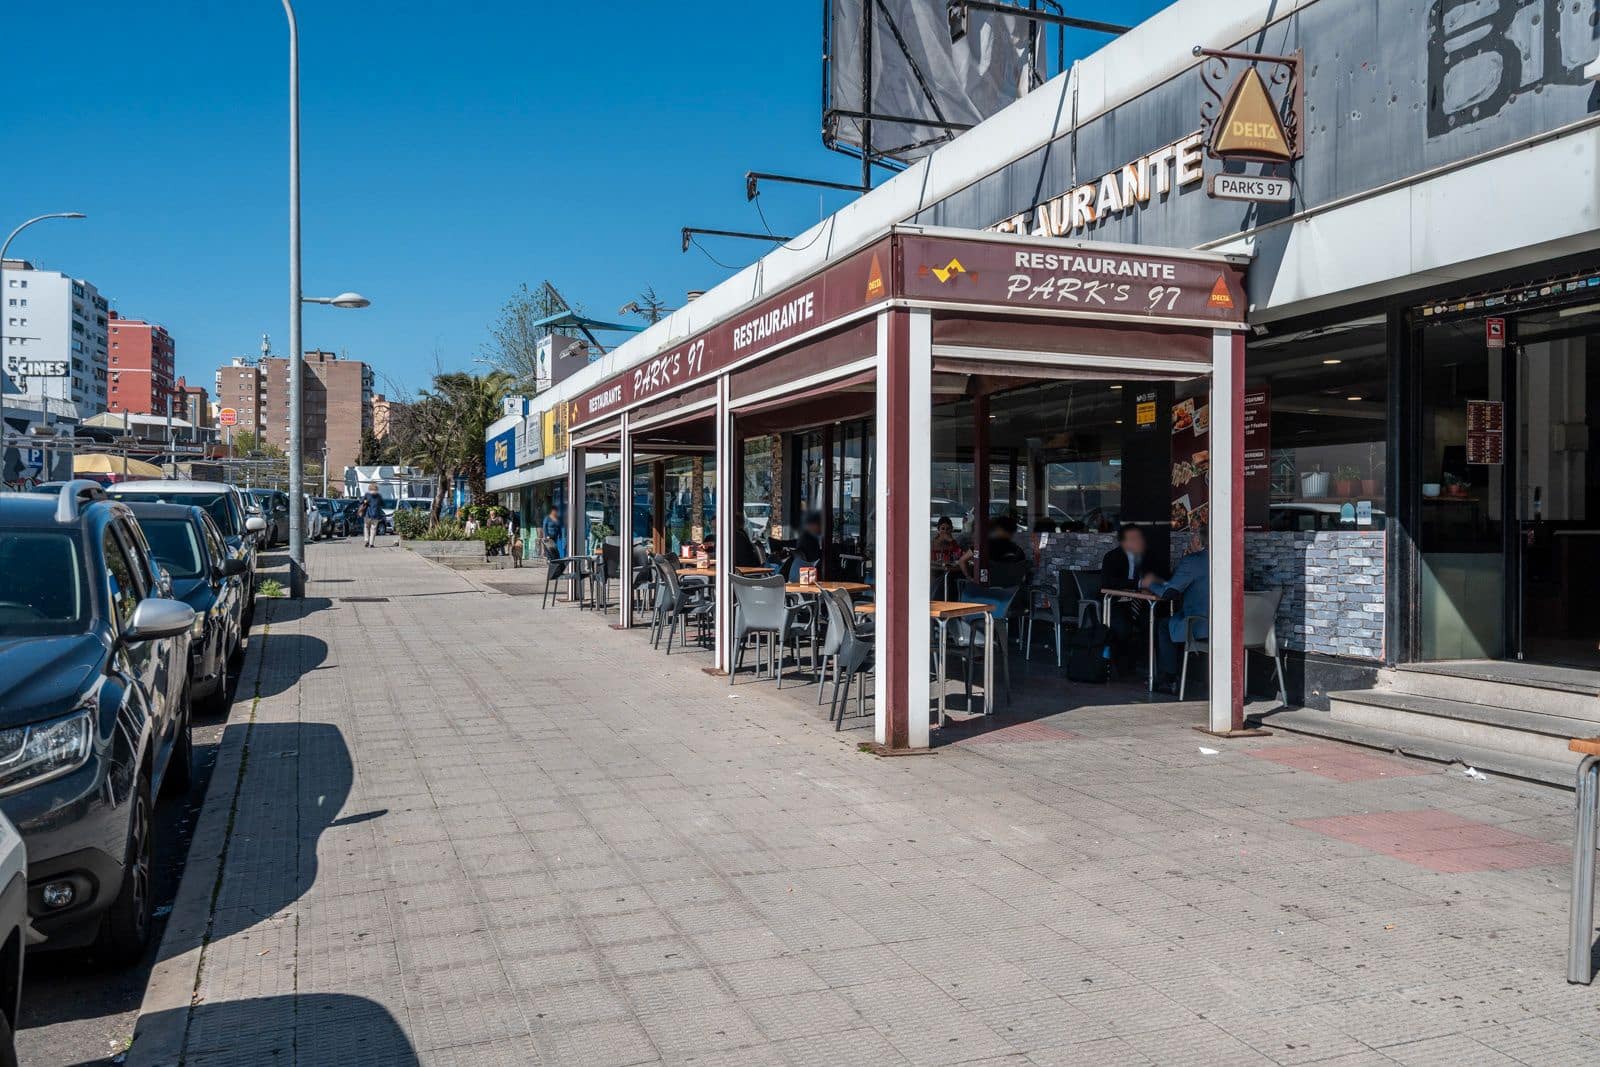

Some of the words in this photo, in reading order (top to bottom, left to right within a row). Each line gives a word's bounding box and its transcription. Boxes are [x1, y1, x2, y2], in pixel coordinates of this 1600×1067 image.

[1233, 121, 1278, 139] DELTA
[1222, 180, 1264, 195] PARK'S
[1267, 183, 1283, 196] 97
[1015, 251, 1175, 280] RESTAURANTE
[1007, 274, 1130, 305] PARK'S
[1148, 286, 1182, 311] 97
[733, 291, 814, 351] RESTAURANTE
[18, 361, 66, 376] CINES
[633, 352, 681, 400] PARK'S
[687, 339, 705, 376] 97
[588, 384, 622, 413] RESTAURANTE
[32, 449, 40, 461] P
